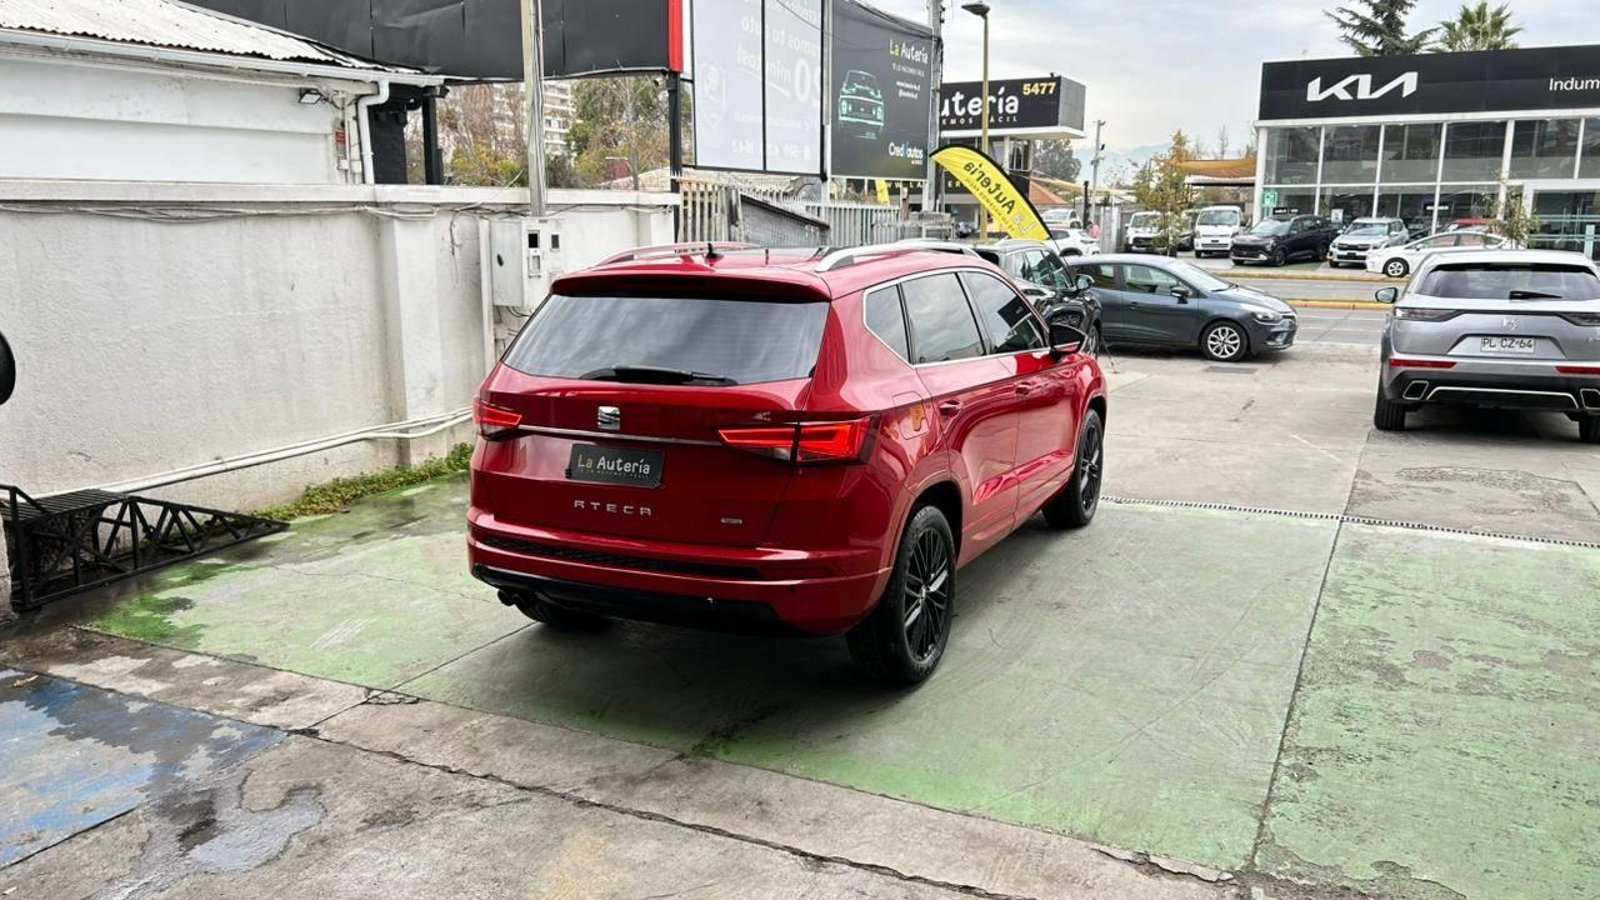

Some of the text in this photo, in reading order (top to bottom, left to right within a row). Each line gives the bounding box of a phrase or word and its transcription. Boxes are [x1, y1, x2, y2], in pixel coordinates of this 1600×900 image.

[889, 39, 899, 56] La
[1022, 81, 1056, 96] 5477
[1306, 71, 1418, 101] KIA
[1549, 76, 1600, 91] Indum
[578, 454, 593, 469] La
[596, 455, 651, 475] Autería
[574, 499, 652, 516] ATECA
